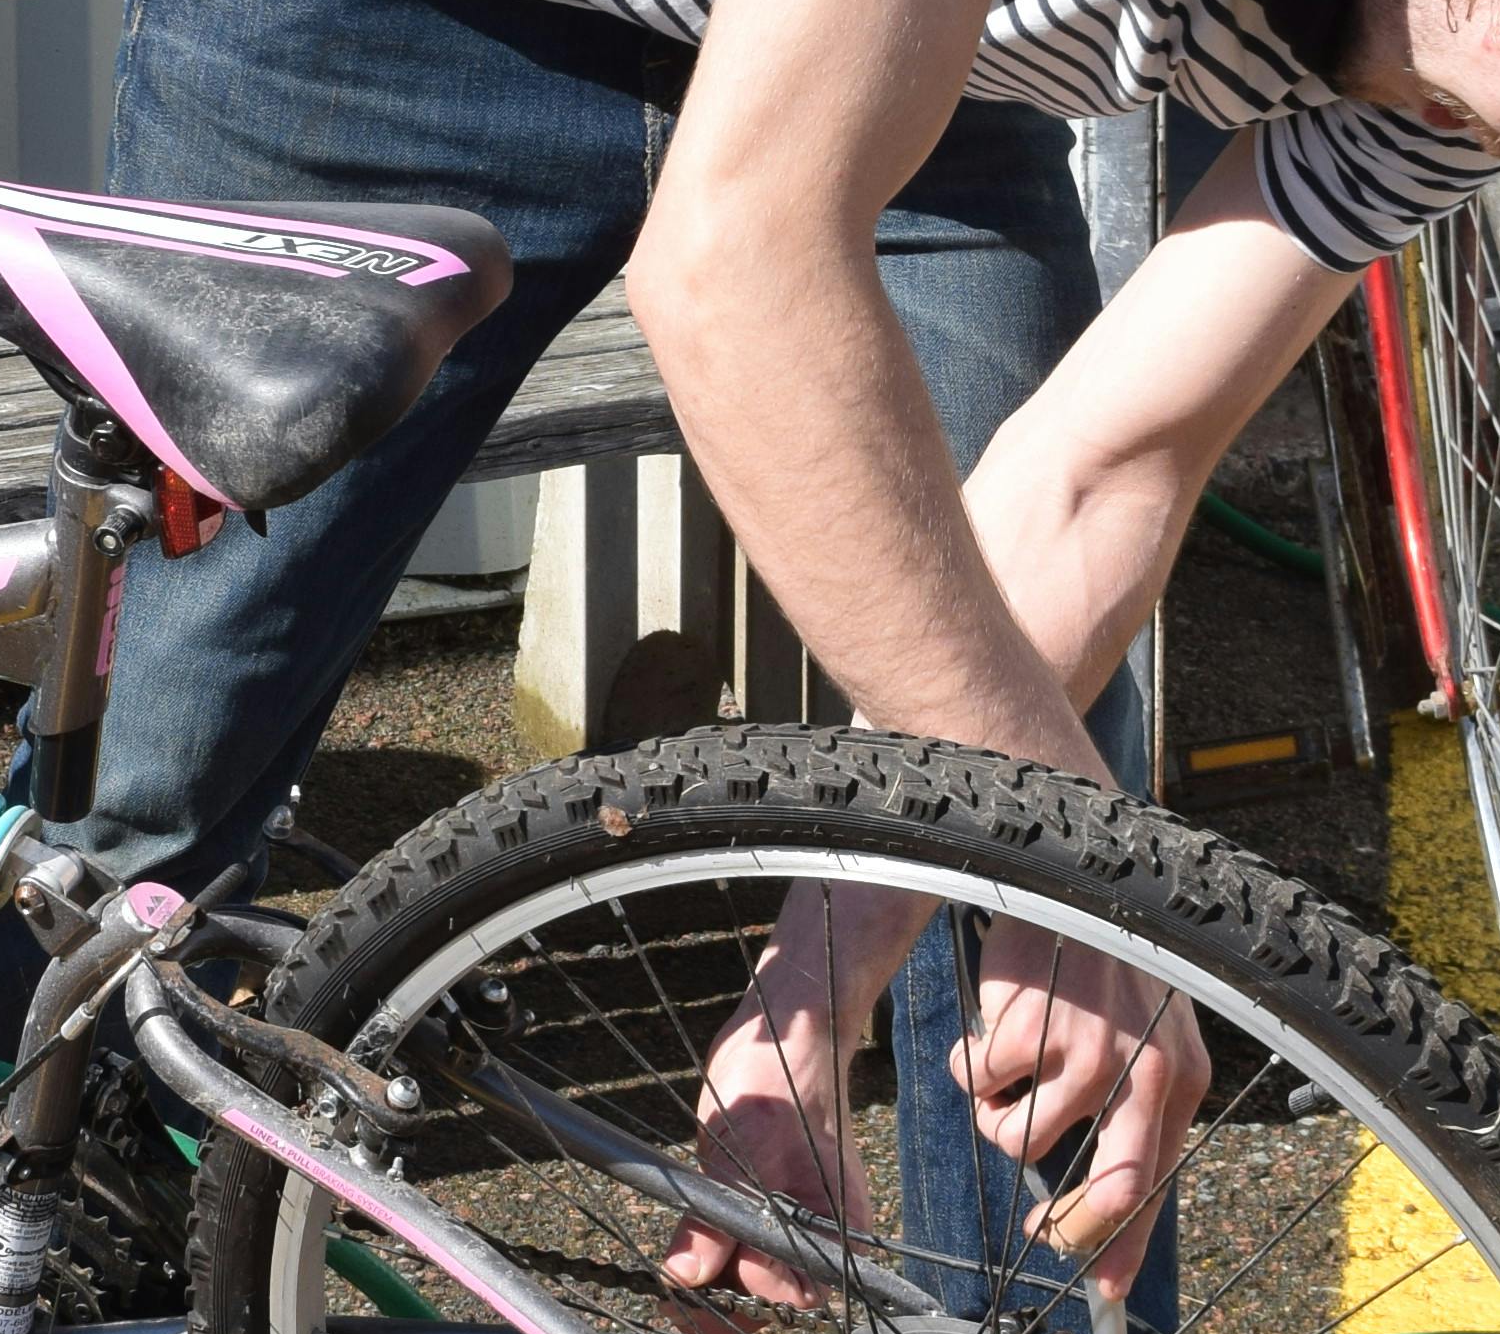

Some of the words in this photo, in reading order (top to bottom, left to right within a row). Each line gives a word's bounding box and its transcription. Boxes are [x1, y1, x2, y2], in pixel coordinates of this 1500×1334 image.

[221, 234, 418, 275] NEXT
[287, 1147, 312, 1171] PULL
[312, 1164, 356, 1202] BRAKING
[355, 1195, 394, 1224] SYSTEM
